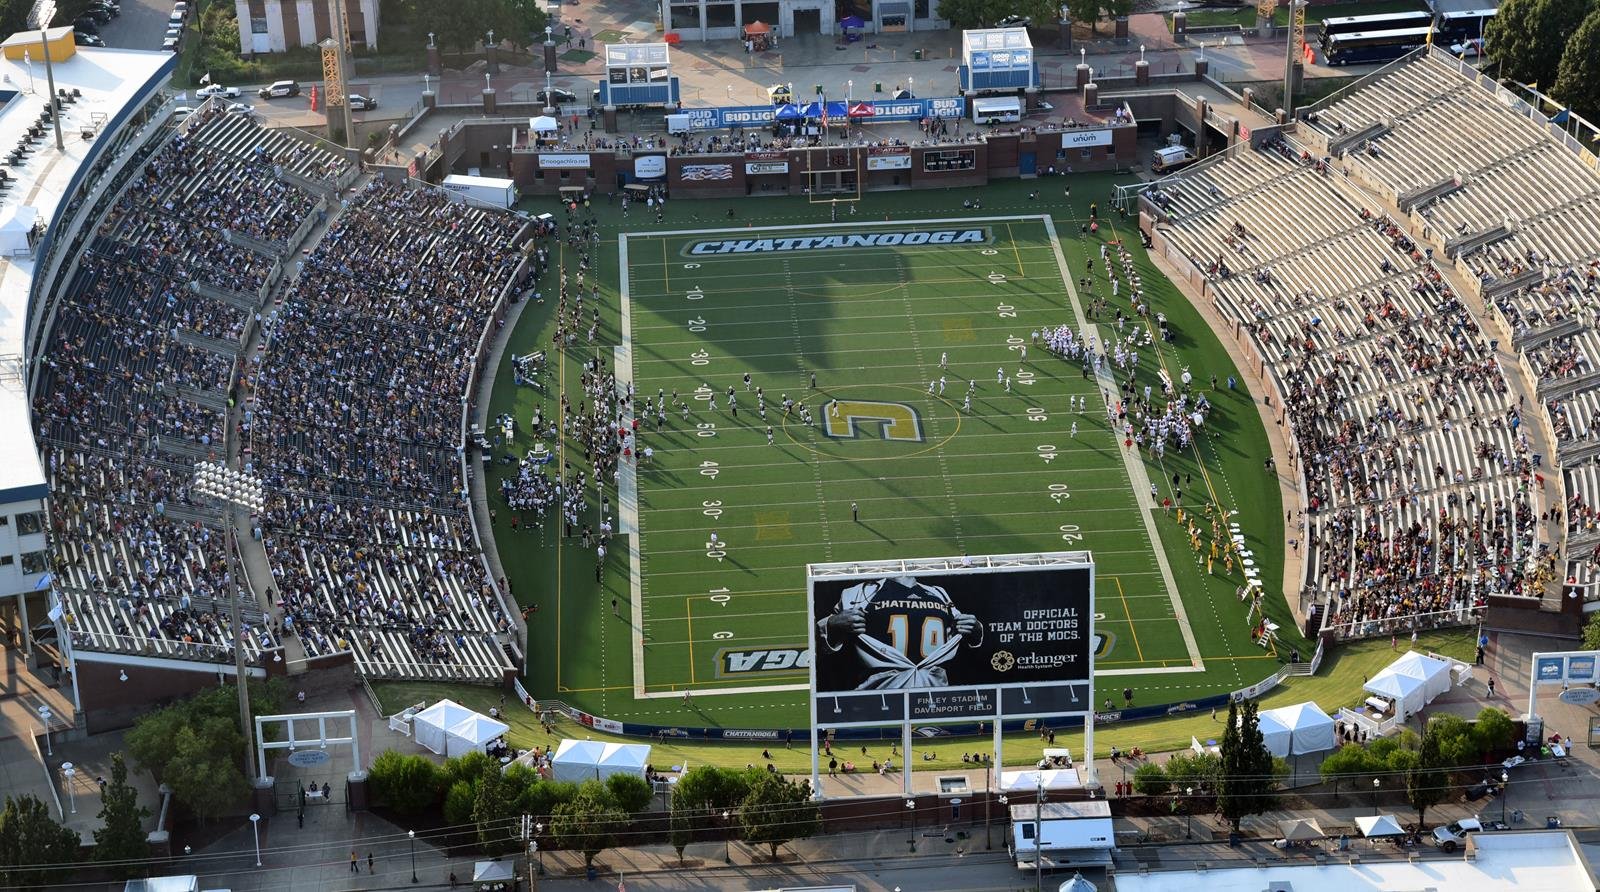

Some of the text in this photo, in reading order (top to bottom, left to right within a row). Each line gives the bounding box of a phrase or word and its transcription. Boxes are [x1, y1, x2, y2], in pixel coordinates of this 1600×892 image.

[885, 105, 920, 115] LIGHT
[933, 100, 957, 109] BUD
[688, 110, 712, 119] BUD
[725, 111, 775, 122] BUD LIG
[928, 107, 961, 117] LIGHT
[689, 118, 717, 127] IGHT
[691, 230, 984, 254] CHATTANOOGA
[997, 305, 1017, 318] 20
[688, 319, 707, 332] 20
[691, 352, 710, 366] 30
[1016, 371, 1037, 385] 40
[694, 387, 712, 401] 40
[1026, 407, 1048, 421] 50
[697, 423, 716, 437] 50
[1037, 444, 1058, 460] 40
[699, 460, 719, 476] 40
[1048, 484, 1070, 499] 30
[702, 500, 723, 516] 30
[1060, 524, 1083, 541] 20
[709, 587, 731, 602] 10
[874, 600, 949, 615] CHATTANOOG
[1023, 607, 1078, 620] OFFICIAL
[989, 619, 1078, 632] TEAM DOCTORS
[999, 630, 1081, 643] OF THE MOCS.
[1016, 651, 1078, 668] erlanger
[914, 705, 964, 714] DAVENPORT
[724, 730, 778, 738] CHATTANOOGA
